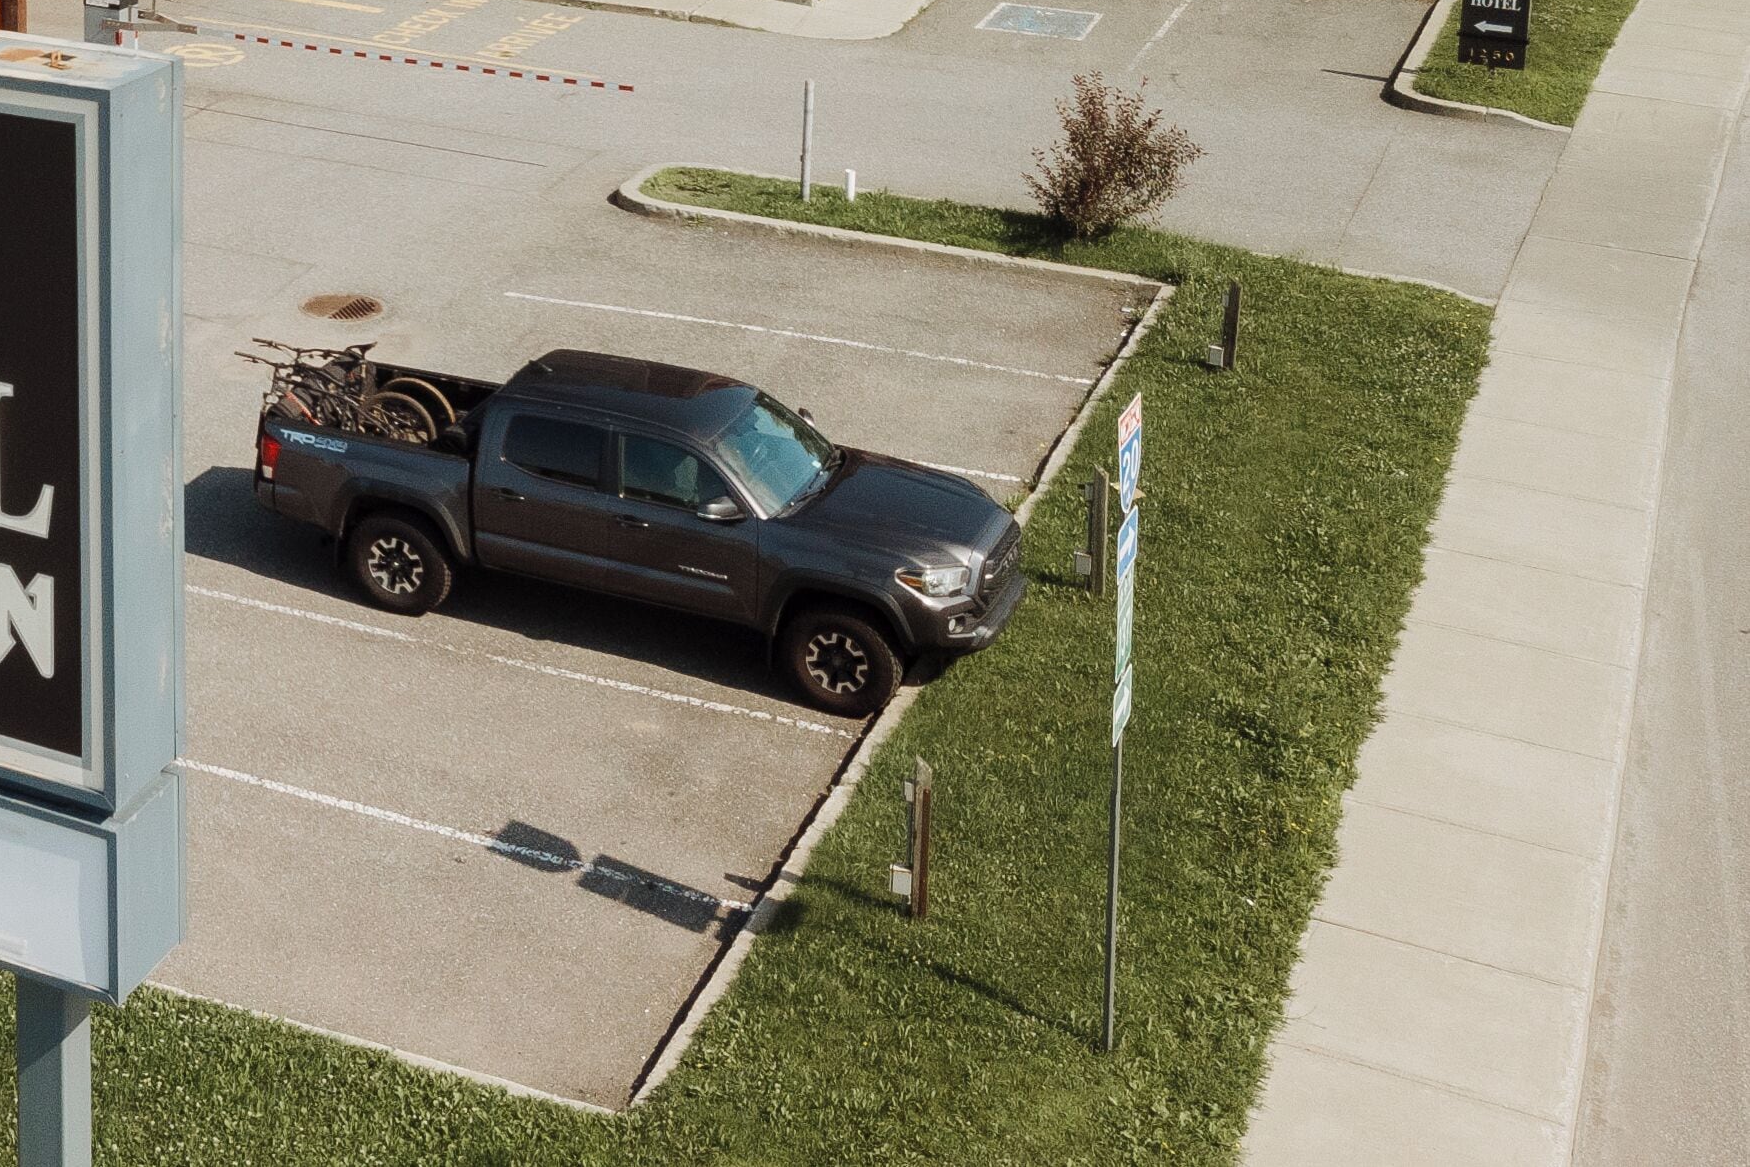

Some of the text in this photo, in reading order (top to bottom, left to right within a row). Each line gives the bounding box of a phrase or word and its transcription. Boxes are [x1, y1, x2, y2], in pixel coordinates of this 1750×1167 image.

[372, 8, 466, 45] CHECK
[473, 12, 586, 60] ARRIVÉE
[1122, 438, 1139, 495] 20
